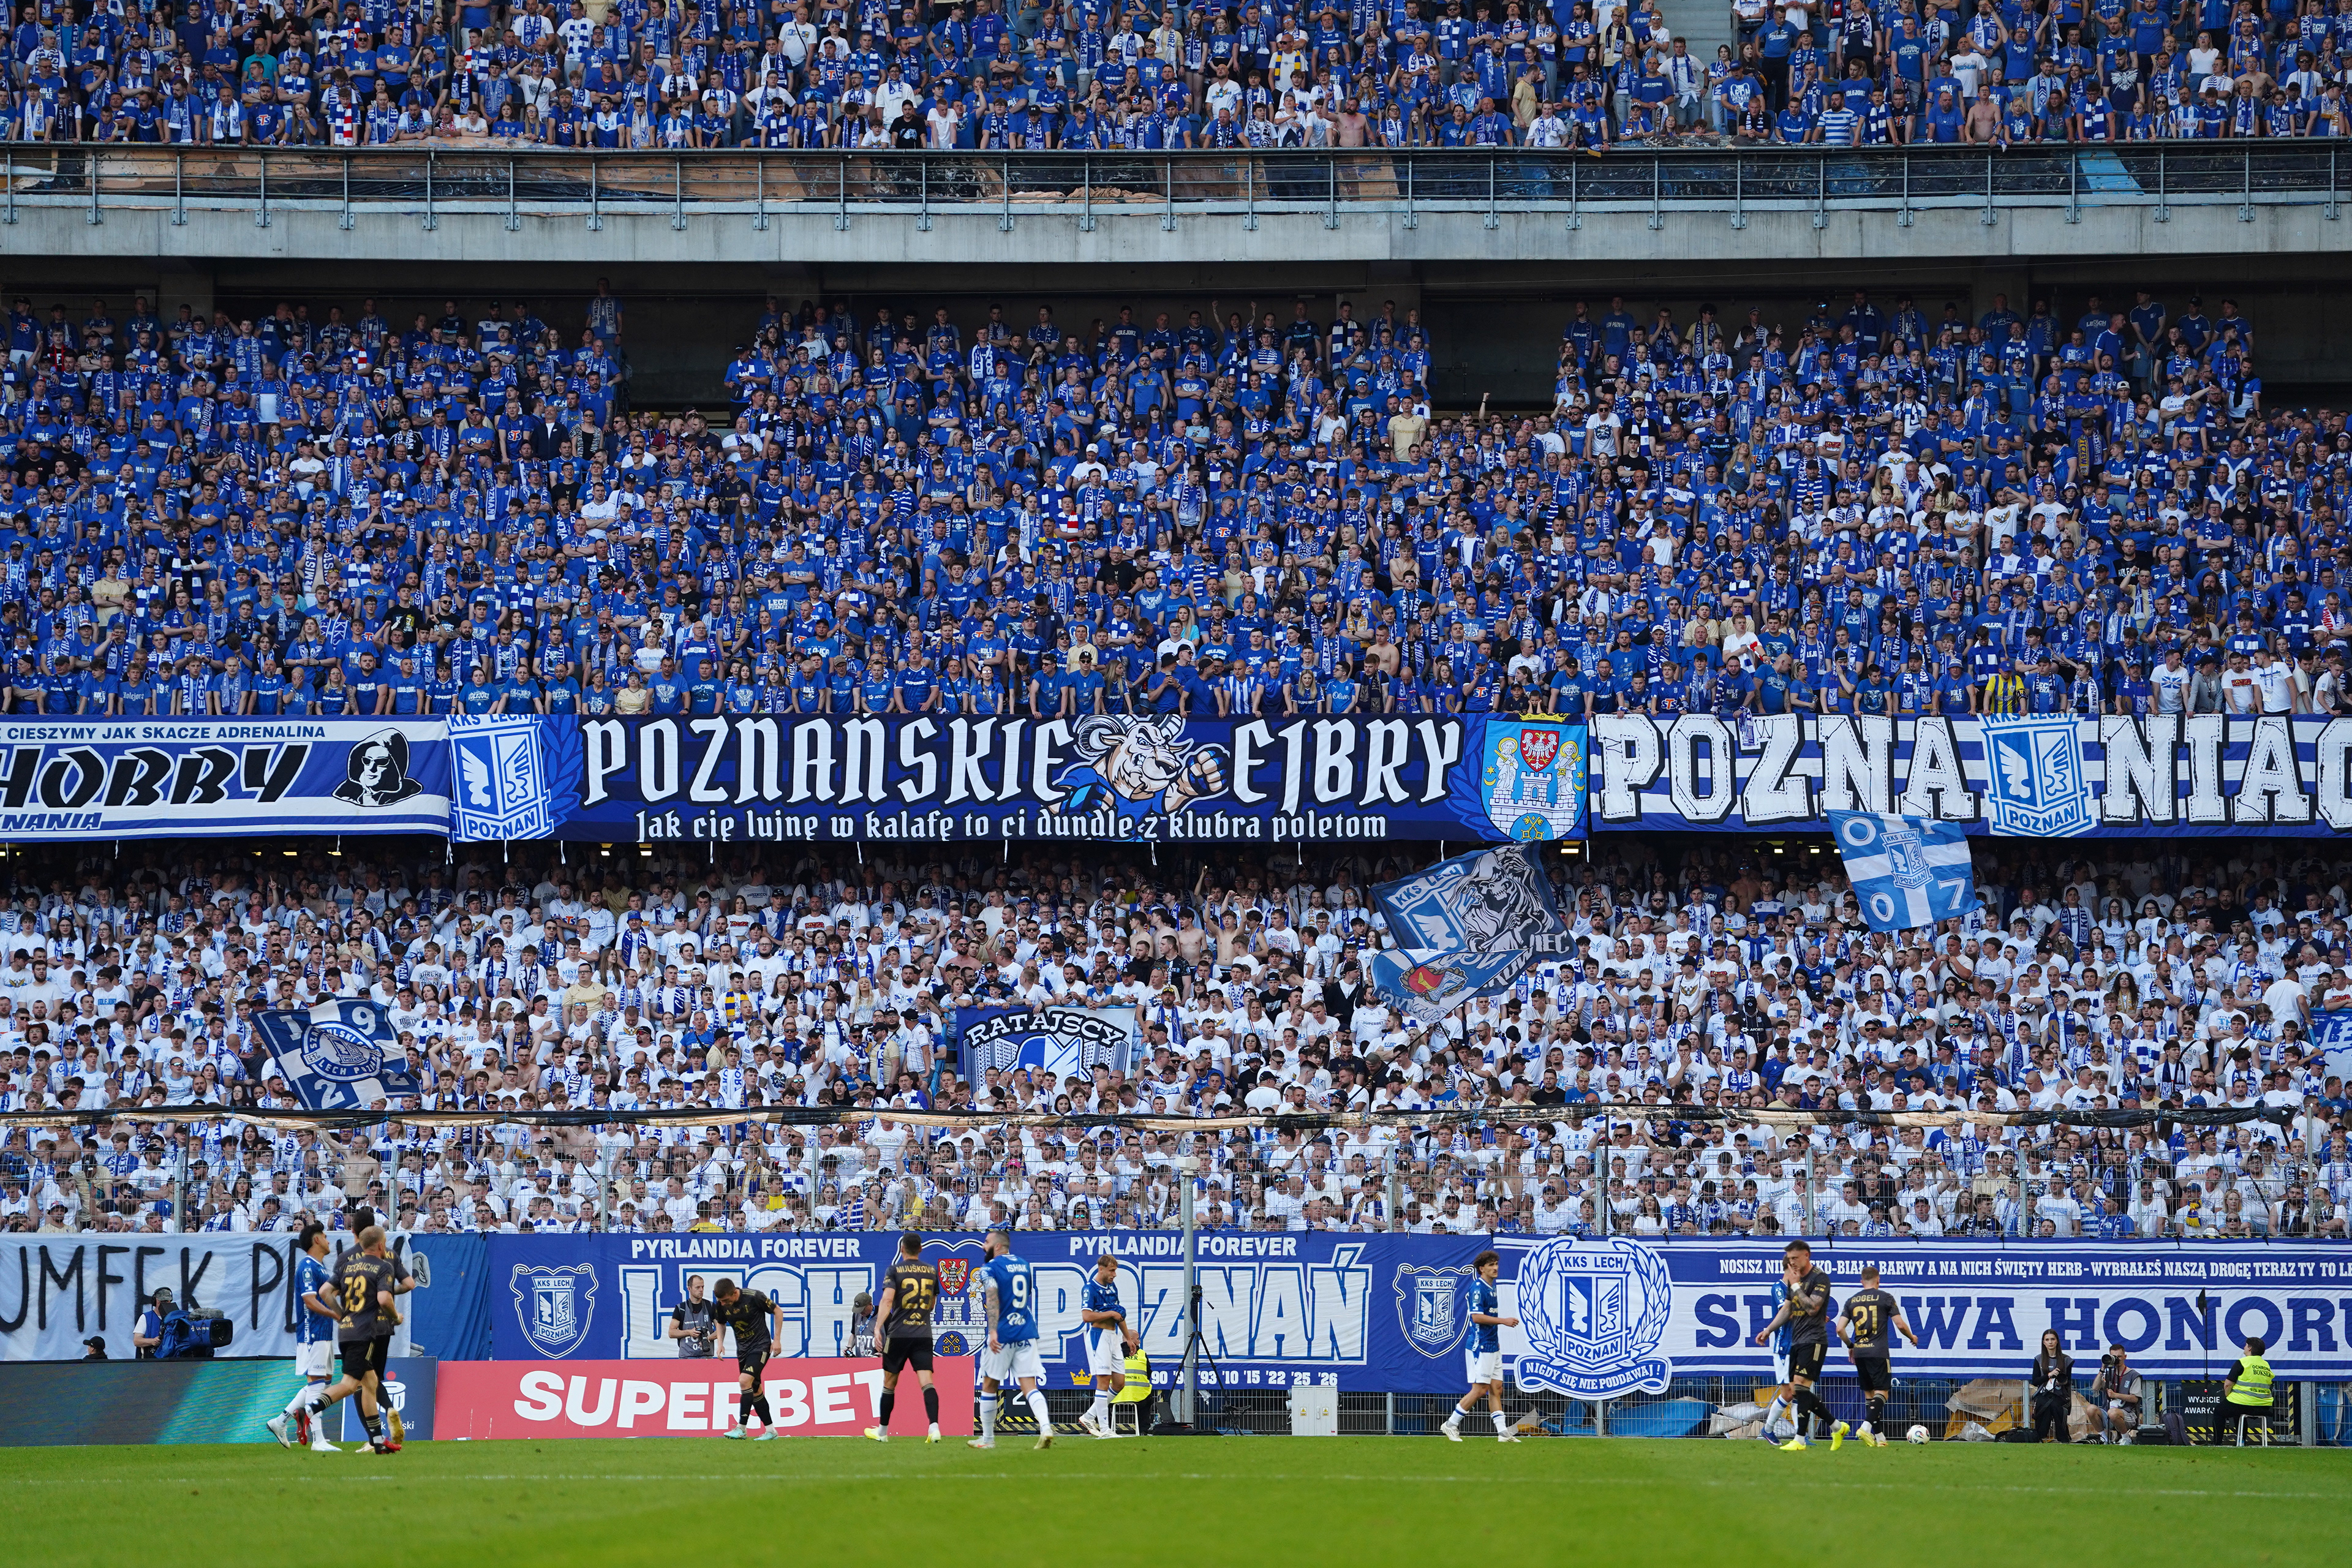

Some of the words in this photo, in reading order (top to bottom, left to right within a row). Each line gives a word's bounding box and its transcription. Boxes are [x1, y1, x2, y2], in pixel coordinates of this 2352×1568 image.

[256, 114, 270, 126] STS
[559, 123, 573, 133] STS
[17, 323, 30, 333] STS
[507, 429, 522, 441] STS
[1315, 526, 1329, 537] STS
[1473, 687, 1488, 698] STS
[1661, 699, 1678, 709] STS
[449, 714, 481, 727] KKS
[7, 727, 97, 739] CIESZYMY
[102, 726, 137, 739] JAK
[141, 726, 211, 739] SKACZE
[216, 725, 326, 738] ADRENALINA
[582, 715, 1077, 808] POZNAŃSKIE
[1597, 713, 1980, 824] POZNA
[0, 812, 102, 829] NANIA
[2008, 802, 2075, 831] POZNAŃ
[467, 810, 535, 840] POZNAŃ
[636, 810, 682, 842] Jak
[693, 809, 735, 842] cię
[746, 809, 819, 841] lujnę
[830, 816, 854, 837] w
[865, 809, 954, 842] kalafę
[964, 813, 989, 837] to
[1001, 809, 1025, 837] ci
[1036, 809, 1133, 838] dundle
[1168, 810, 1261, 838] klubra
[1271, 809, 1386, 842] poletom
[1900, 872, 1926, 885] POZNAŃ
[1395, 884, 1423, 907] KKS
[1937, 877, 1966, 910] 7
[278, 1014, 302, 1041] 1
[352, 1006, 376, 1036] 9
[966, 1012, 1126, 1046] RATAJSCY
[306, 1053, 321, 1063] EST.
[318, 1061, 347, 1076] LECH
[314, 1078, 346, 1109] 2
[631, 1238, 755, 1259] PYRLANDIA
[761, 1238, 861, 1258] FOREVER
[1069, 1235, 1185, 1256] PYRLANDIA
[1197, 1236, 1297, 1256] FOREVER
[1005, 1264, 1028, 1273] ISHAK
[1564, 1256, 1588, 1267] KKS
[1594, 1256, 1623, 1267] LECH
[1719, 1259, 1763, 1274] NOSISZ
[1879, 1261, 1925, 1275] BARWY
[1928, 1261, 1937, 1275] A
[1939, 1261, 1959, 1275] NA
[1961, 1261, 1992, 1276] NICH
[1995, 1258, 2045, 1278] ŚWIĘTY
[2164, 1262, 2207, 1279] NASZĄ
[2210, 1262, 2252, 1280] DROGĘ
[2253, 1262, 2296, 1277] TERAZ
[2297, 1262, 2315, 1277] TY
[2320, 1262, 2336, 1277] TO
[537, 1279, 551, 1287] KKS
[552, 1279, 570, 1287] LECH
[1420, 1279, 1434, 1287] KKS
[1435, 1279, 1453, 1288] LECH
[344, 1275, 367, 1313] 13
[901, 1277, 934, 1310] 25
[1012, 1274, 1028, 1309] 9
[1851, 1294, 1880, 1303] ROGELJ
[1852, 1305, 1878, 1336] 21
[2045, 1295, 2352, 1353] HONOR
[540, 1326, 571, 1339] POZNAŃ
[1420, 1327, 1448, 1340] POZNAŃ
[1567, 1339, 1619, 1360] POZNAŃ
[1197, 1370, 1218, 1384] '93
[1221, 1370, 1240, 1384] '10
[1243, 1370, 1261, 1384] '15
[1265, 1370, 1286, 1385] '22
[1291, 1371, 1311, 1385] '25
[1317, 1371, 1338, 1385] '26
[1525, 1362, 1558, 1382] NIGDY
[1559, 1373, 1578, 1390] SIĘ
[1578, 1377, 1597, 1389] NIE
[1599, 1365, 1653, 1389] PODDAWAJ
[2253, 1368, 2272, 1378] BOKSER
[2187, 1395, 2220, 1404] WYJŚCIE
[2184, 1406, 2215, 1415] AWARYJ
